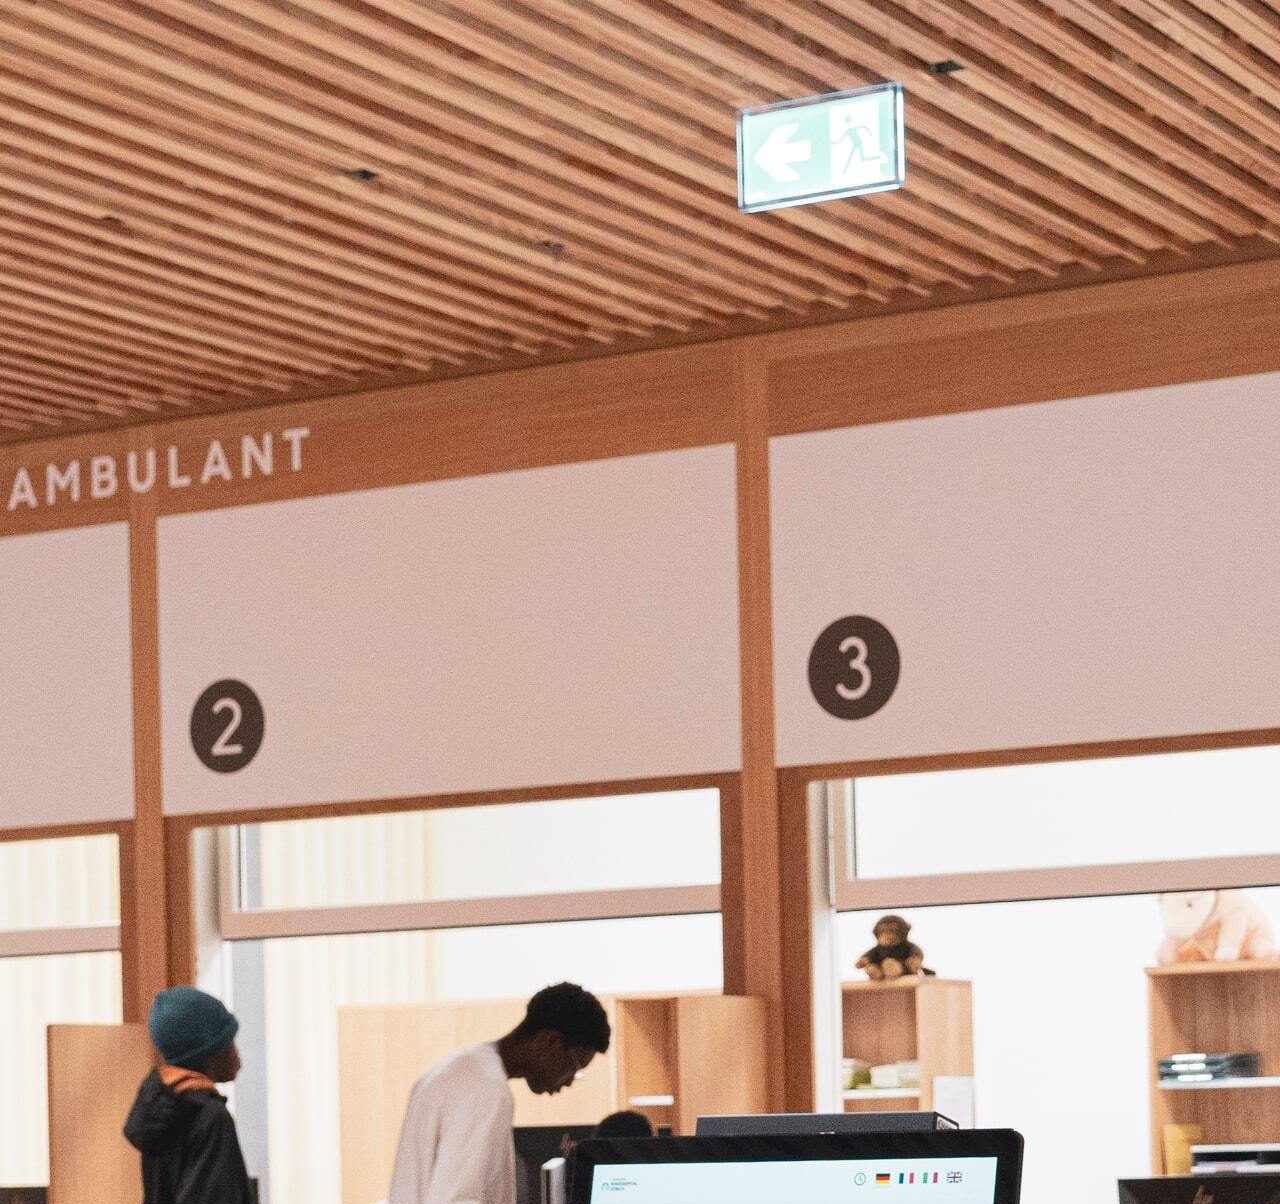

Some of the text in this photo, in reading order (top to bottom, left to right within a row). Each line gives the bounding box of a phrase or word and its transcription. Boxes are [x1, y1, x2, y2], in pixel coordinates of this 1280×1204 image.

[6, 426, 312, 511] AMBULANT
[835, 635, 872, 701] 3
[209, 696, 244, 757] 2
